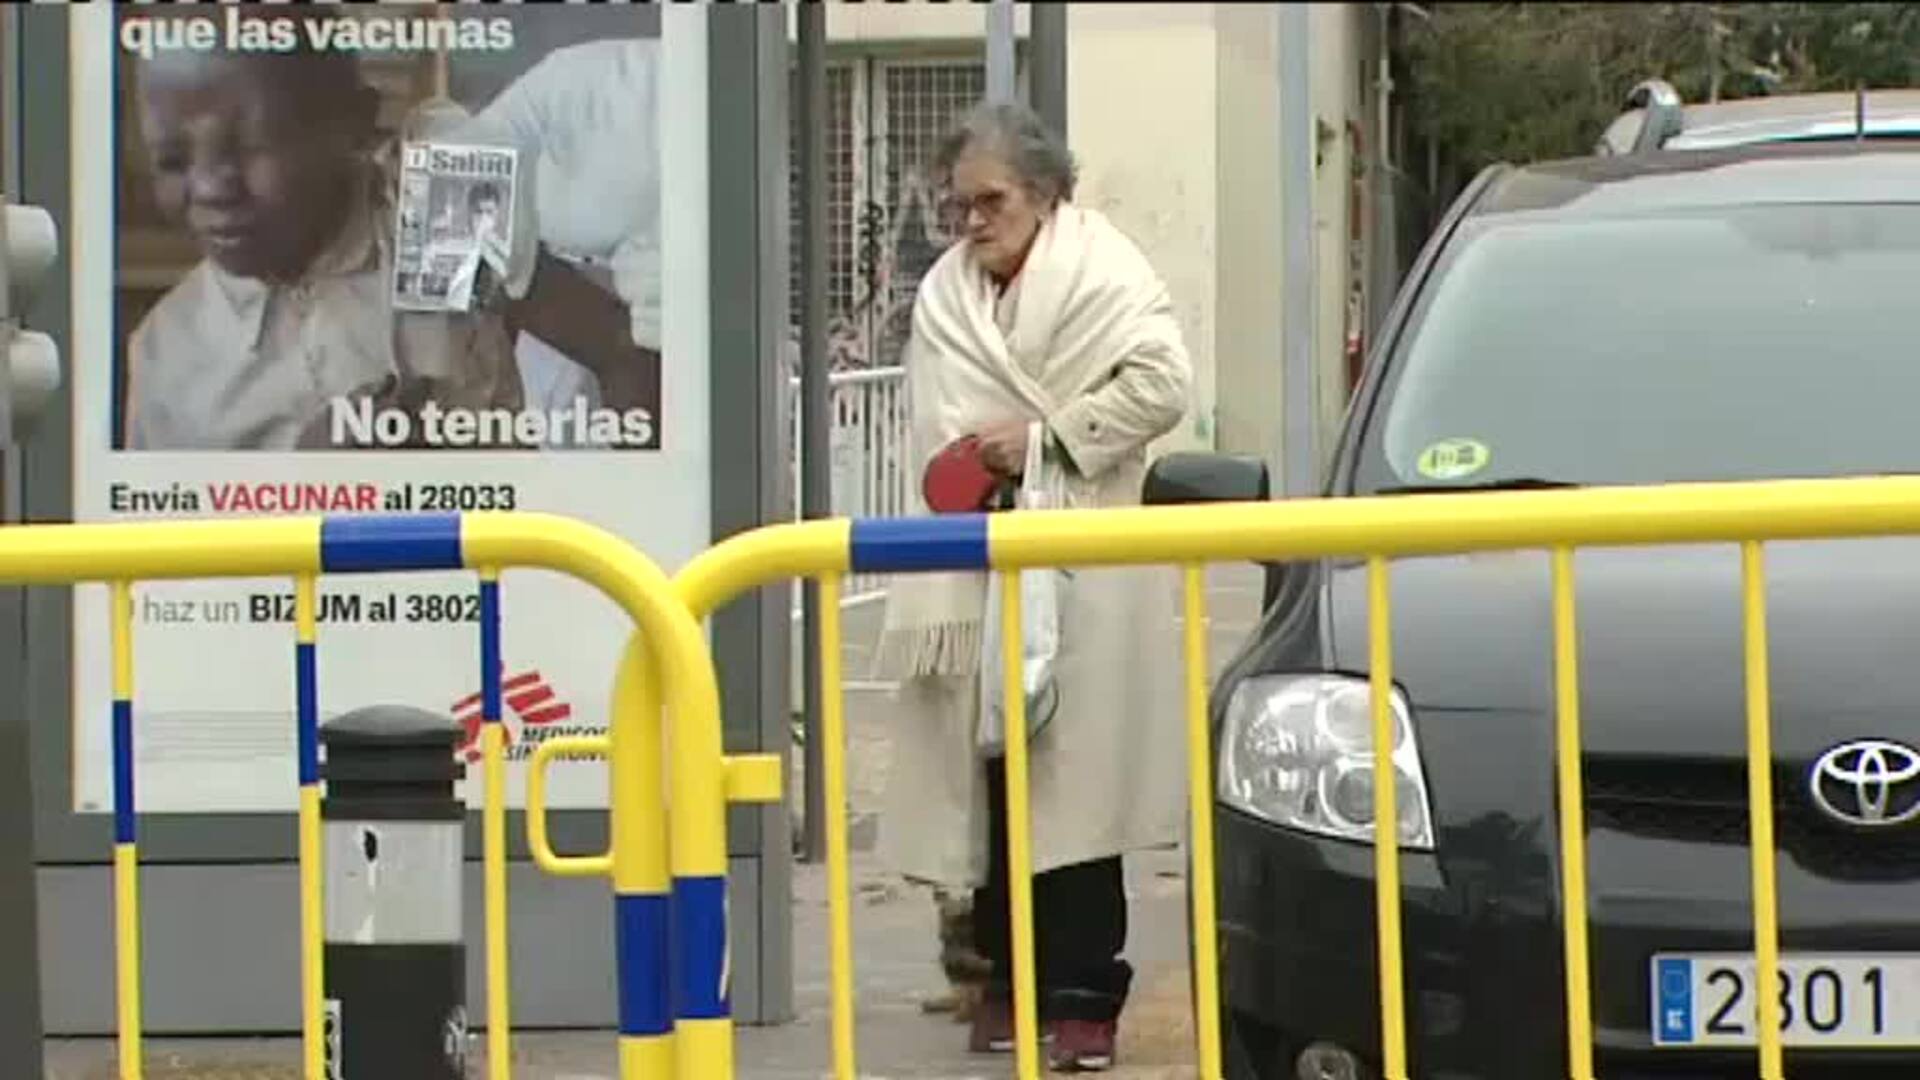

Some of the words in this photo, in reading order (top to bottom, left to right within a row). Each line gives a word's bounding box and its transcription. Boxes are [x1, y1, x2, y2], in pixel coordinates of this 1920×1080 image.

[119, 16, 216, 60] que
[224, 5, 298, 51] las
[304, 15, 514, 51] vacunas
[331, 395, 411, 445] No
[420, 395, 653, 445] tenerlas
[208, 485, 377, 512] VACUNAR
[384, 483, 412, 512] al
[420, 485, 516, 512] 28033
[143, 593, 195, 623] haz
[203, 600, 240, 623] un
[368, 593, 396, 623] al
[405, 594, 500, 623] 3802
